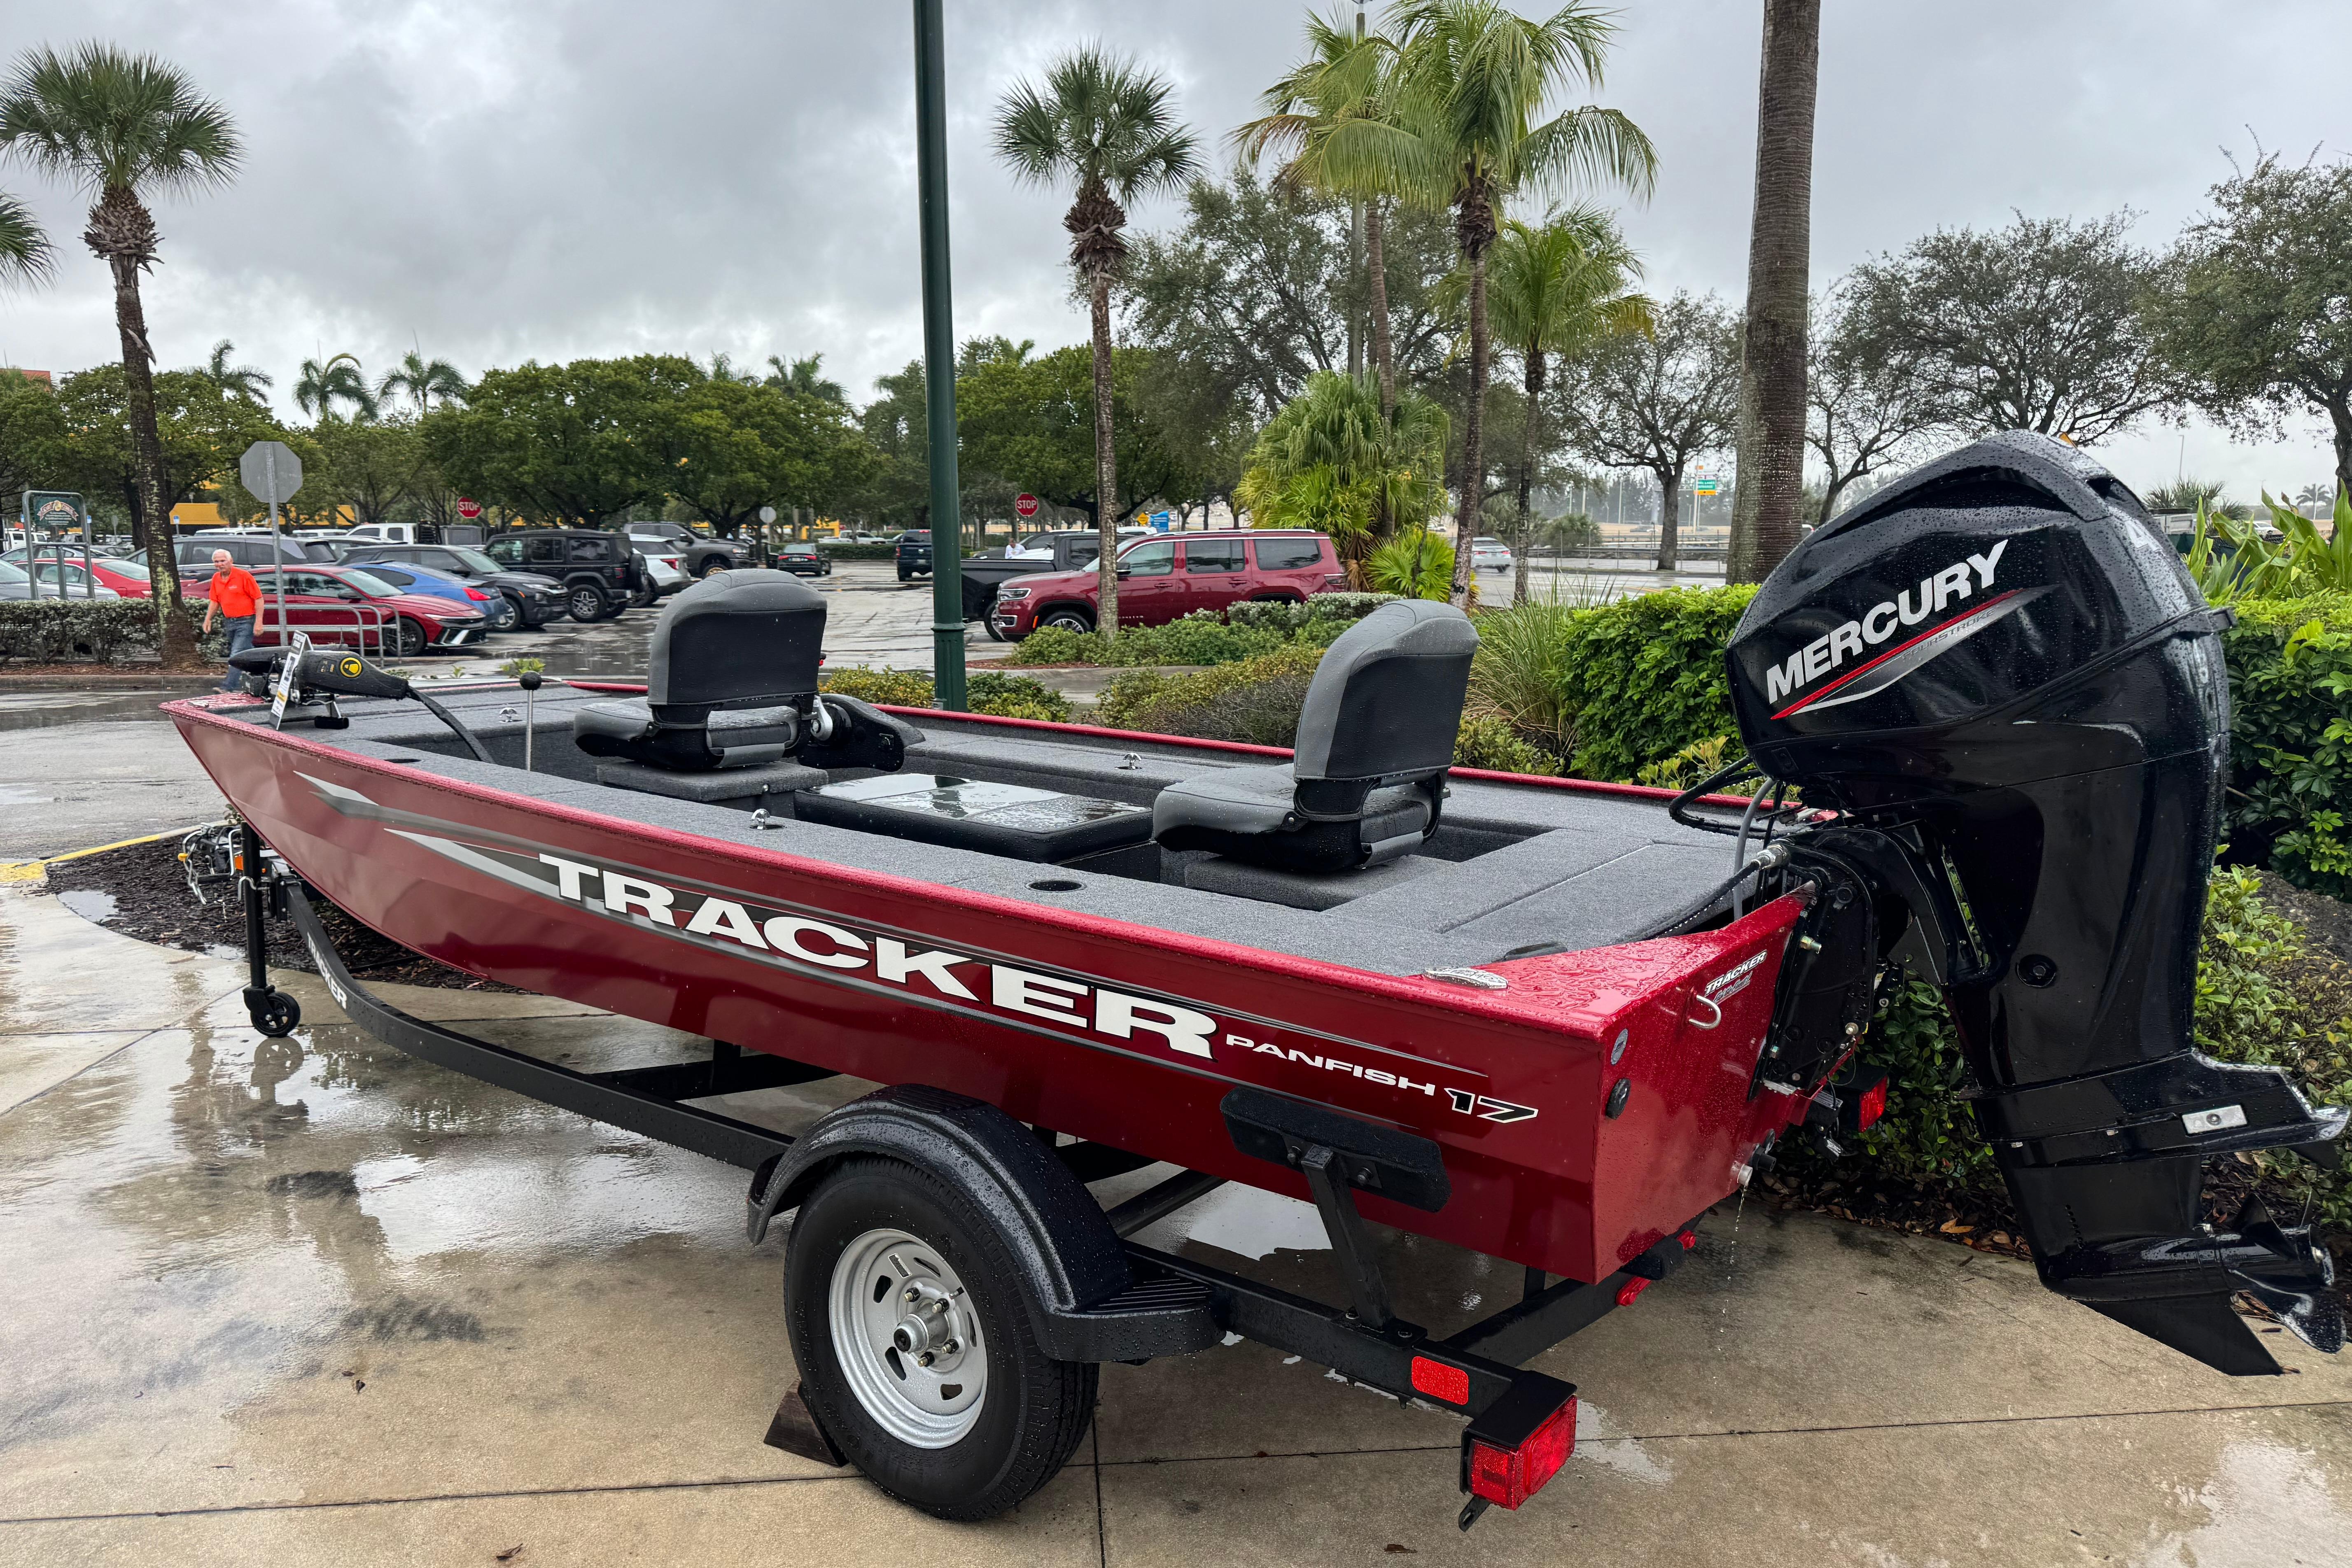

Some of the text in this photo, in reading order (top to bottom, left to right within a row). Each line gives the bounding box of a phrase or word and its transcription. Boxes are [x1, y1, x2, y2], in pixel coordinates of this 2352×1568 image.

[459, 502, 479, 511] STOP
[1017, 500, 1036, 509] STOP
[1766, 539, 2008, 704] MERCURY
[1901, 608, 1995, 660] FOURSTROKE
[307, 932, 347, 1009] TRACKER
[539, 853, 1539, 1124] TRACKER PANFISH 17
[1705, 949, 1767, 997] TRACKER
